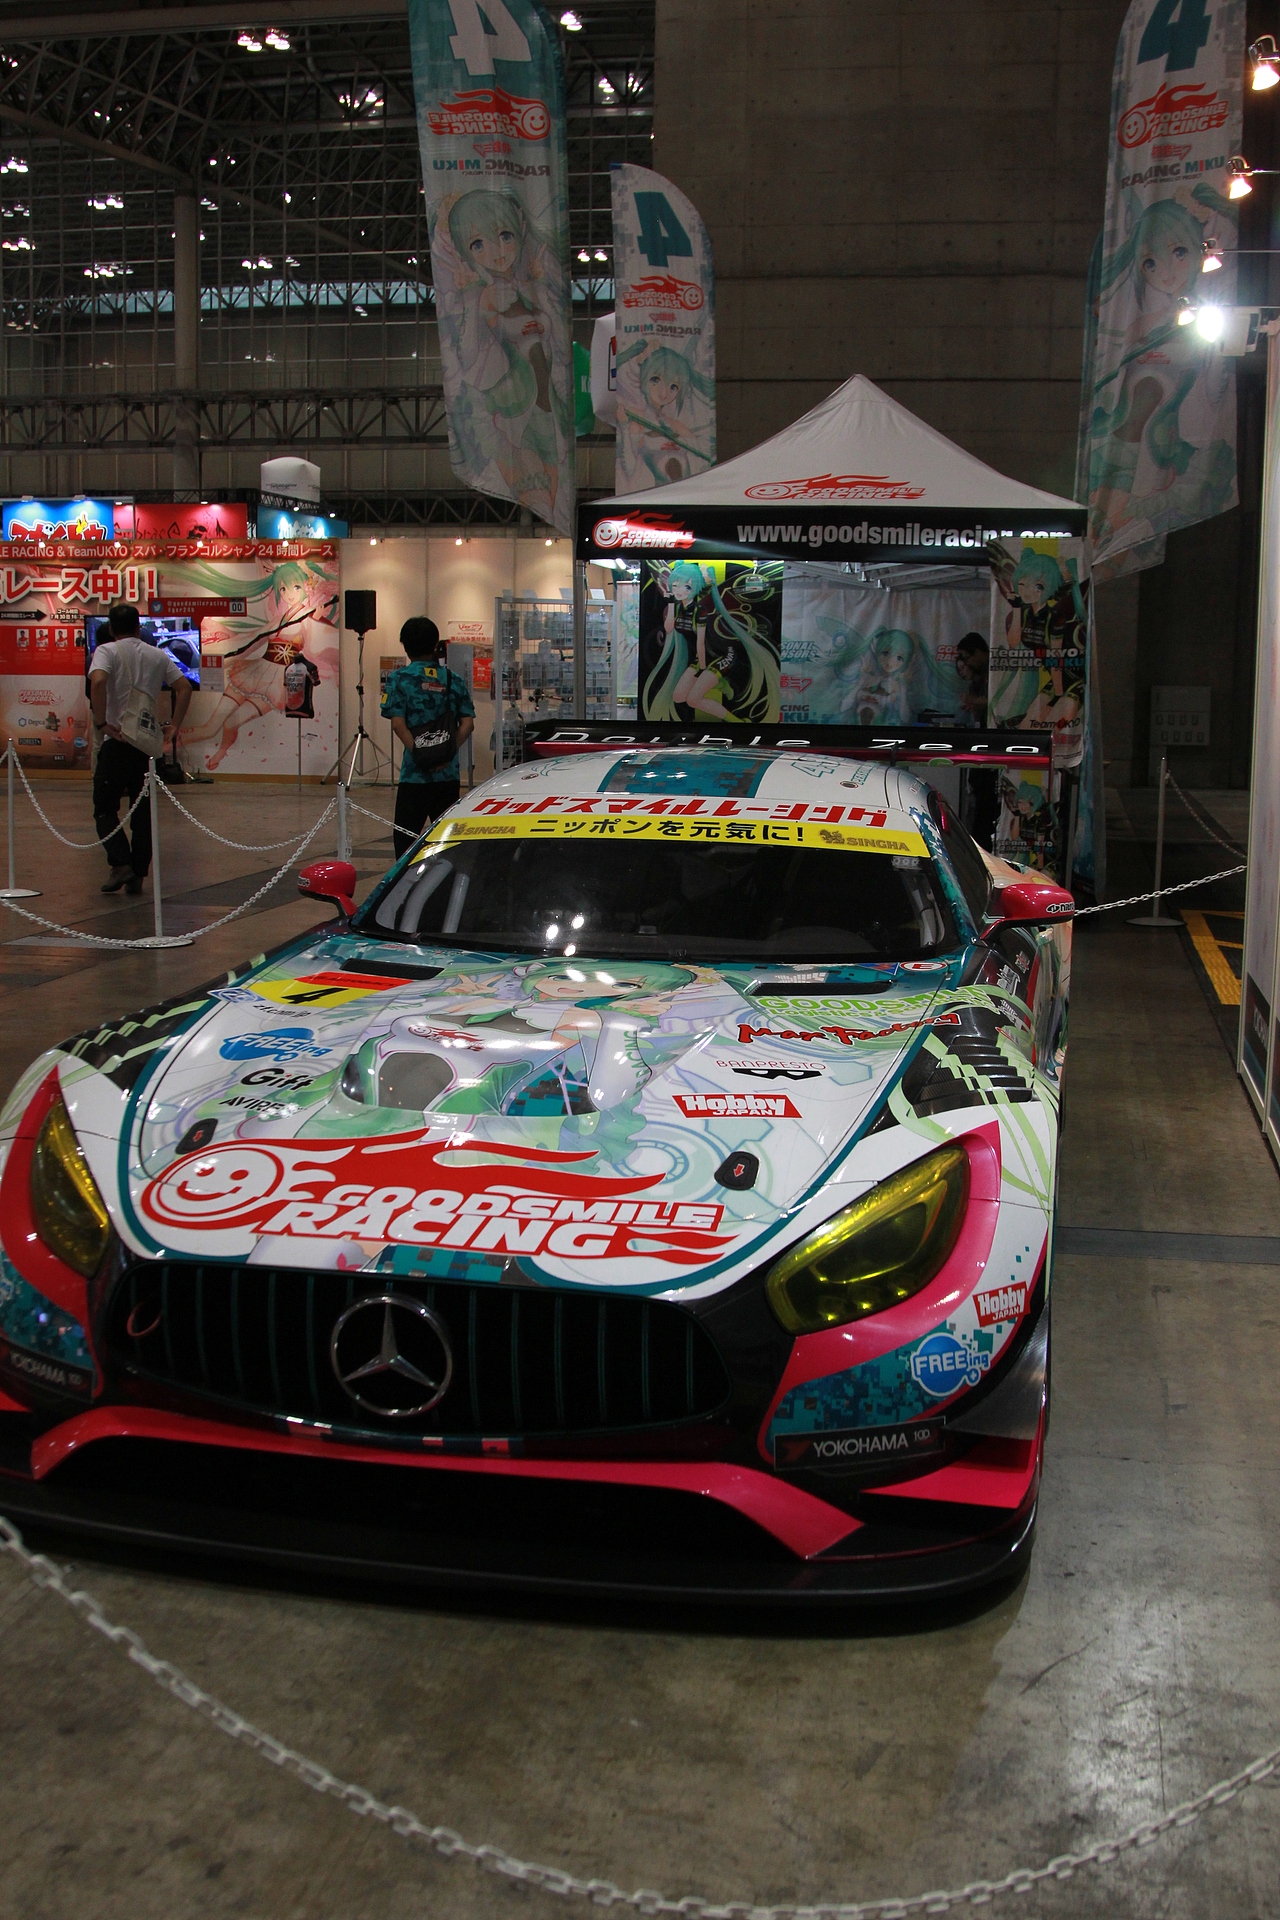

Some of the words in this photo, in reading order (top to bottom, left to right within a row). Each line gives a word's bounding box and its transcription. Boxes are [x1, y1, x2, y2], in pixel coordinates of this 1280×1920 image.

[1137, 0, 1212, 73] 4
[12, 546, 54, 558] RACING
[57, 546, 66, 557] &
[68, 545, 128, 558] TeamUKYO
[620, 537, 677, 548] RACING
[471, 796, 888, 828] グッドスマイルレーシング
[463, 826, 516, 835] SINGHA
[846, 837, 911, 852] SINGHA
[281, 987, 350, 1004] 4
[716, 1060, 827, 1071] BANPRESTO
[240, 1067, 314, 1091] Gift
[681, 1094, 787, 1116] Hobby
[321, 1183, 720, 1229] GOODSMILE
[259, 1201, 619, 1257] RACING
[977, 1287, 1027, 1318] Hobby
[992, 1307, 1020, 1321] JAPAN
[914, 1349, 990, 1376] FREEing
[813, 1432, 909, 1458] YOKOHAMA
